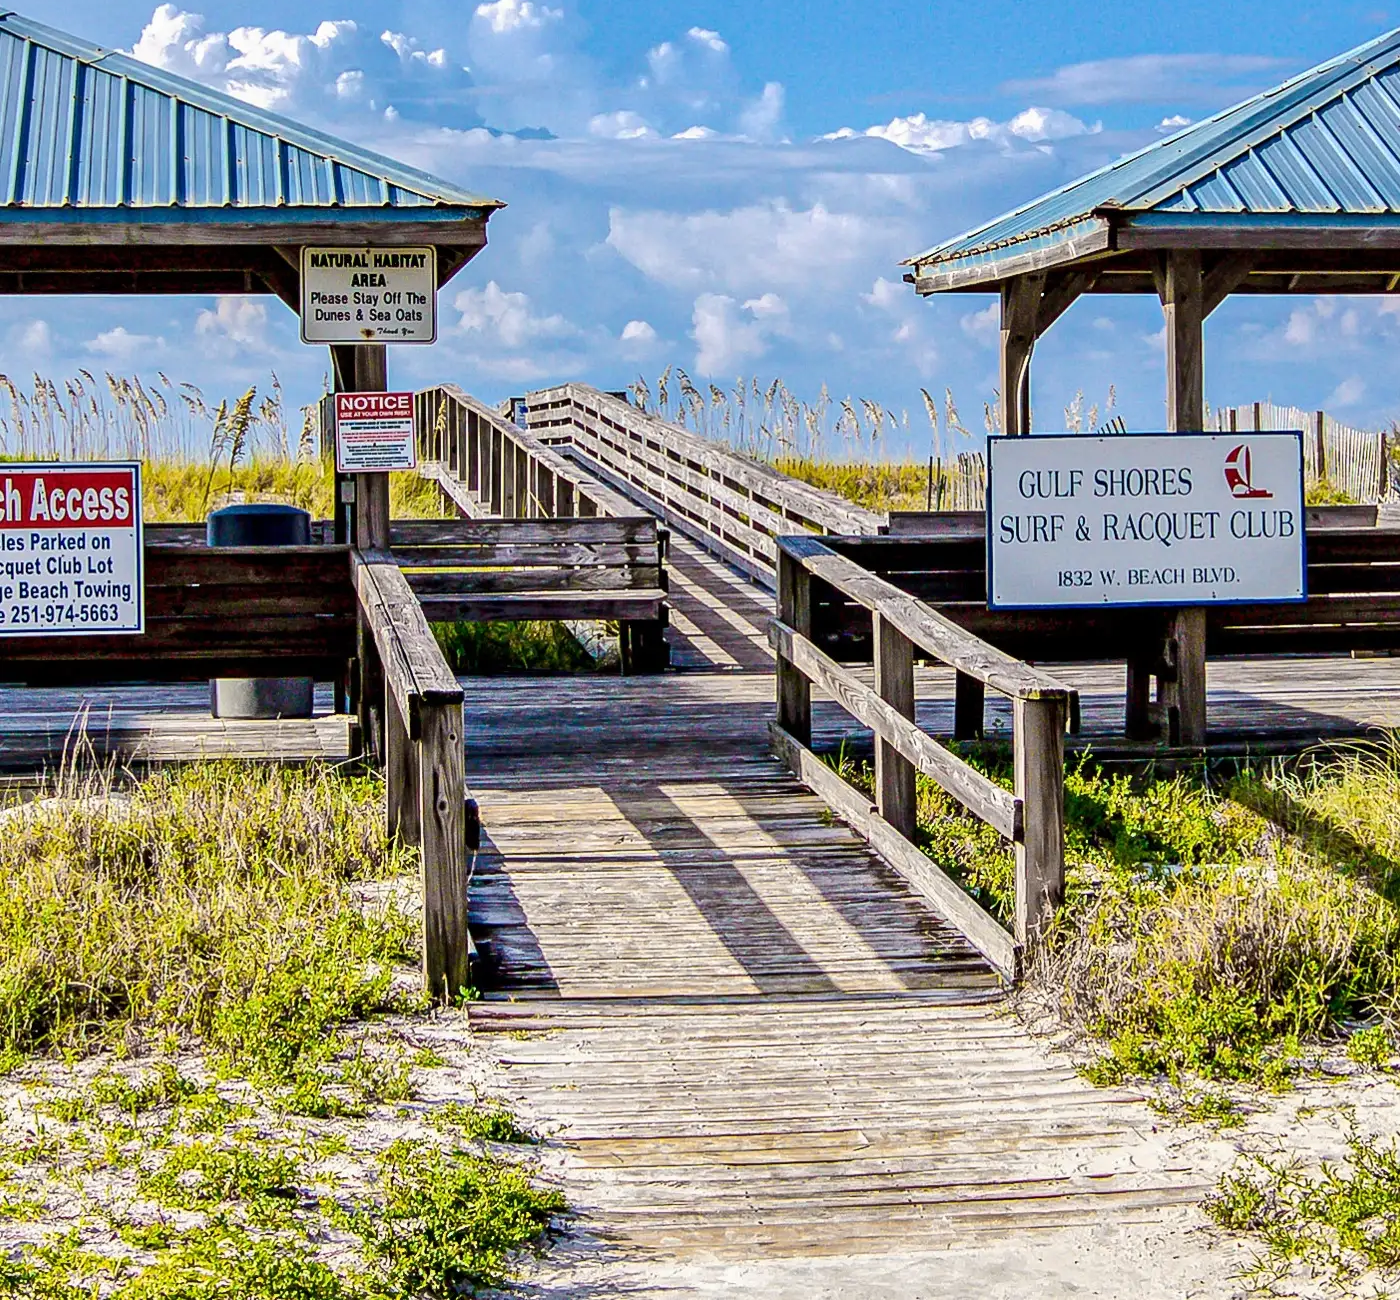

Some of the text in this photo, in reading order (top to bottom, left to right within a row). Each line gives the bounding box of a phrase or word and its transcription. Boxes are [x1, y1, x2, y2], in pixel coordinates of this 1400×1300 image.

[311, 254, 426, 268] NATURAL HABITAT
[351, 273, 386, 287] AREA
[311, 292, 427, 307] Please Stay Off The
[315, 308, 422, 321] Dunes & Sea Oats
[340, 396, 410, 410] NOTICE
[1018, 467, 1193, 499] GULF SHORES
[30, 478, 130, 521] Access
[999, 510, 1295, 547] SURF & RACQUET CLUB
[30, 532, 86, 550] Parked
[91, 536, 111, 550] on
[46, 556, 82, 575] Club
[87, 556, 113, 574] Lot
[1058, 567, 1241, 587] 1832 W. BEACH BLVD.
[19, 581, 69, 599] Beach
[74, 580, 131, 602] Towing
[11, 604, 119, 623] 251-974-5663
